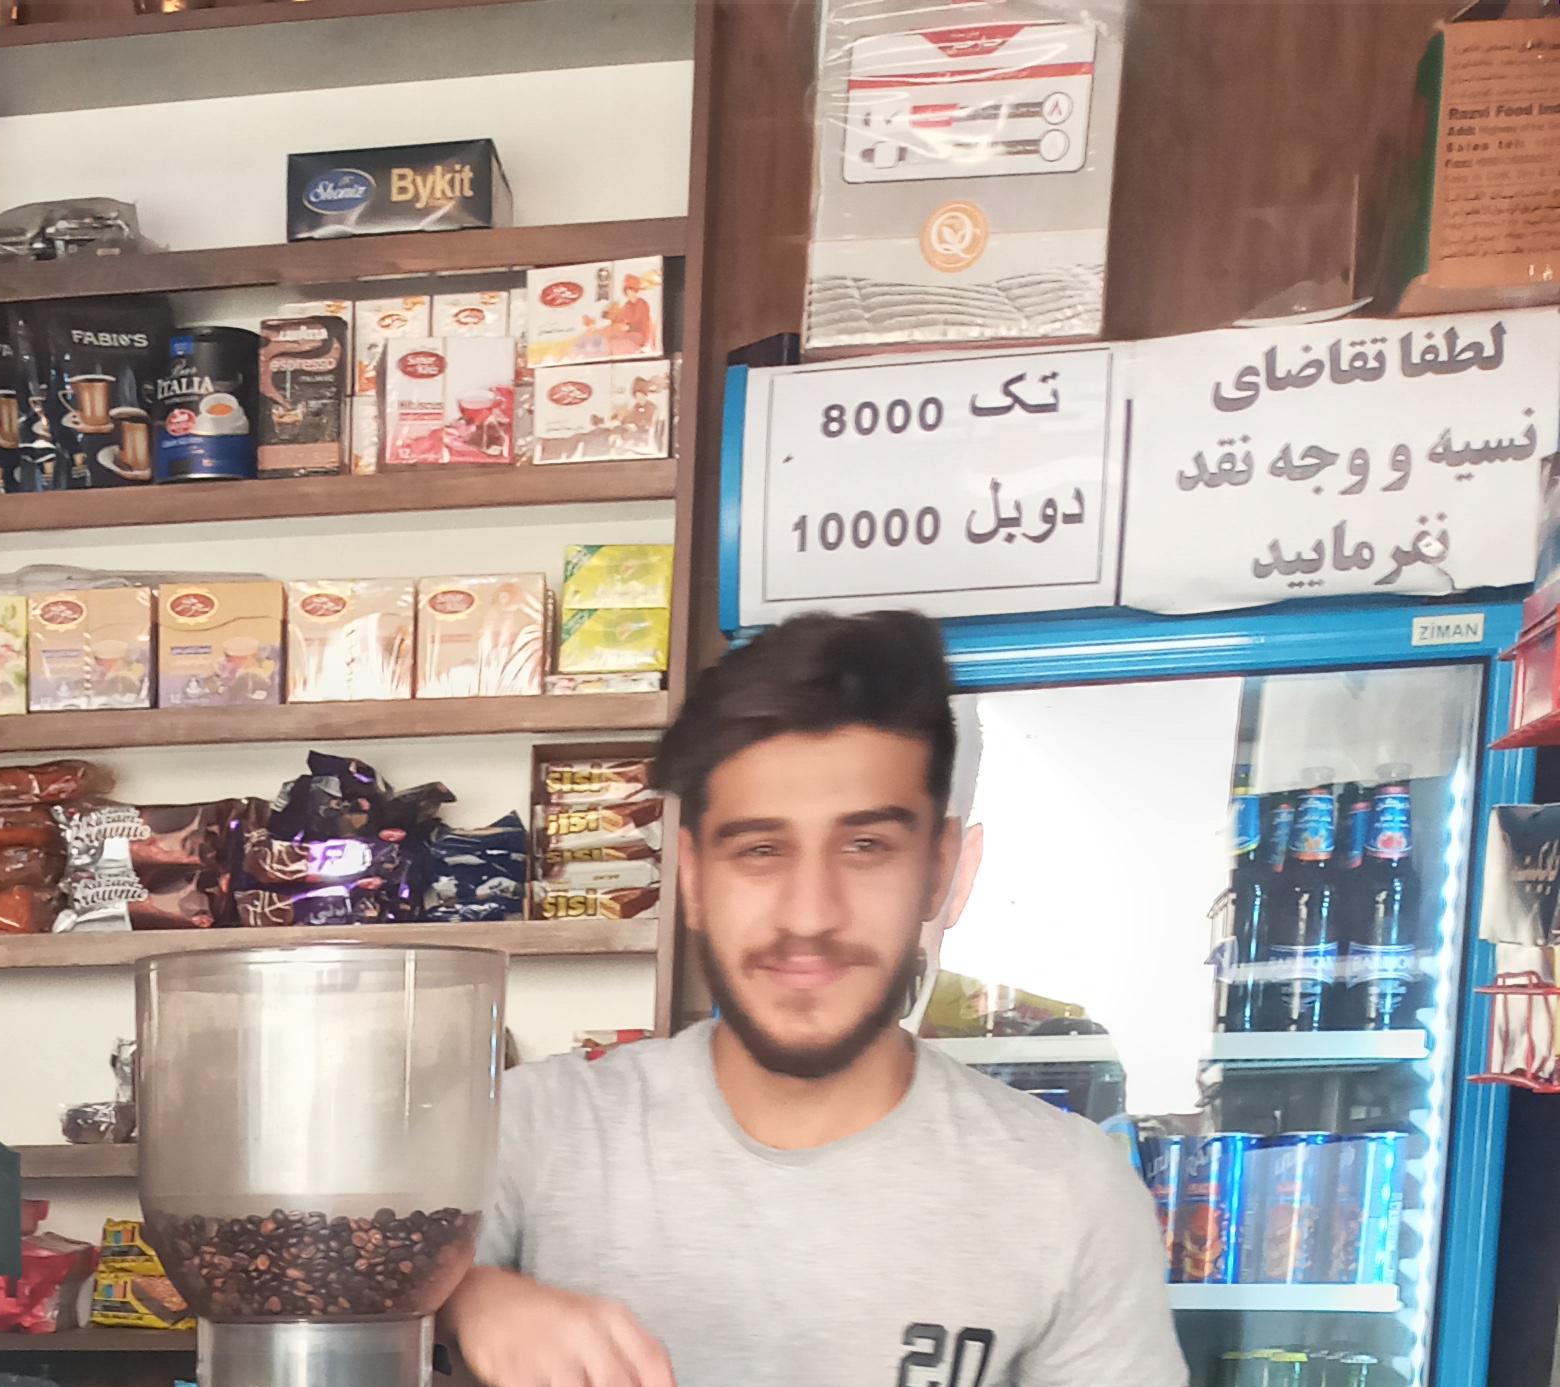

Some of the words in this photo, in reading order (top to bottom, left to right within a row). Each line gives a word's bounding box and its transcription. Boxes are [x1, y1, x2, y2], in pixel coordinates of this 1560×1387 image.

[1496, 103, 1533, 117] Food
[390, 164, 475, 210] Bykit
[269, 357, 338, 372] espresso
[1211, 335, 1389, 413] تقاضای
[1398, 321, 1508, 379] لطفا
[156, 376, 215, 400] ITALIA
[968, 370, 1061, 417] تک
[820, 396, 945, 439] 8000
[1176, 434, 1256, 492] نقد
[1266, 441, 1371, 496] وجه
[1380, 442, 1413, 493] و
[1425, 406, 1539, 483] نسیه
[791, 504, 942, 553] 10000
[964, 476, 1086, 545] دوبل
[541, 895, 598, 918] SISI
